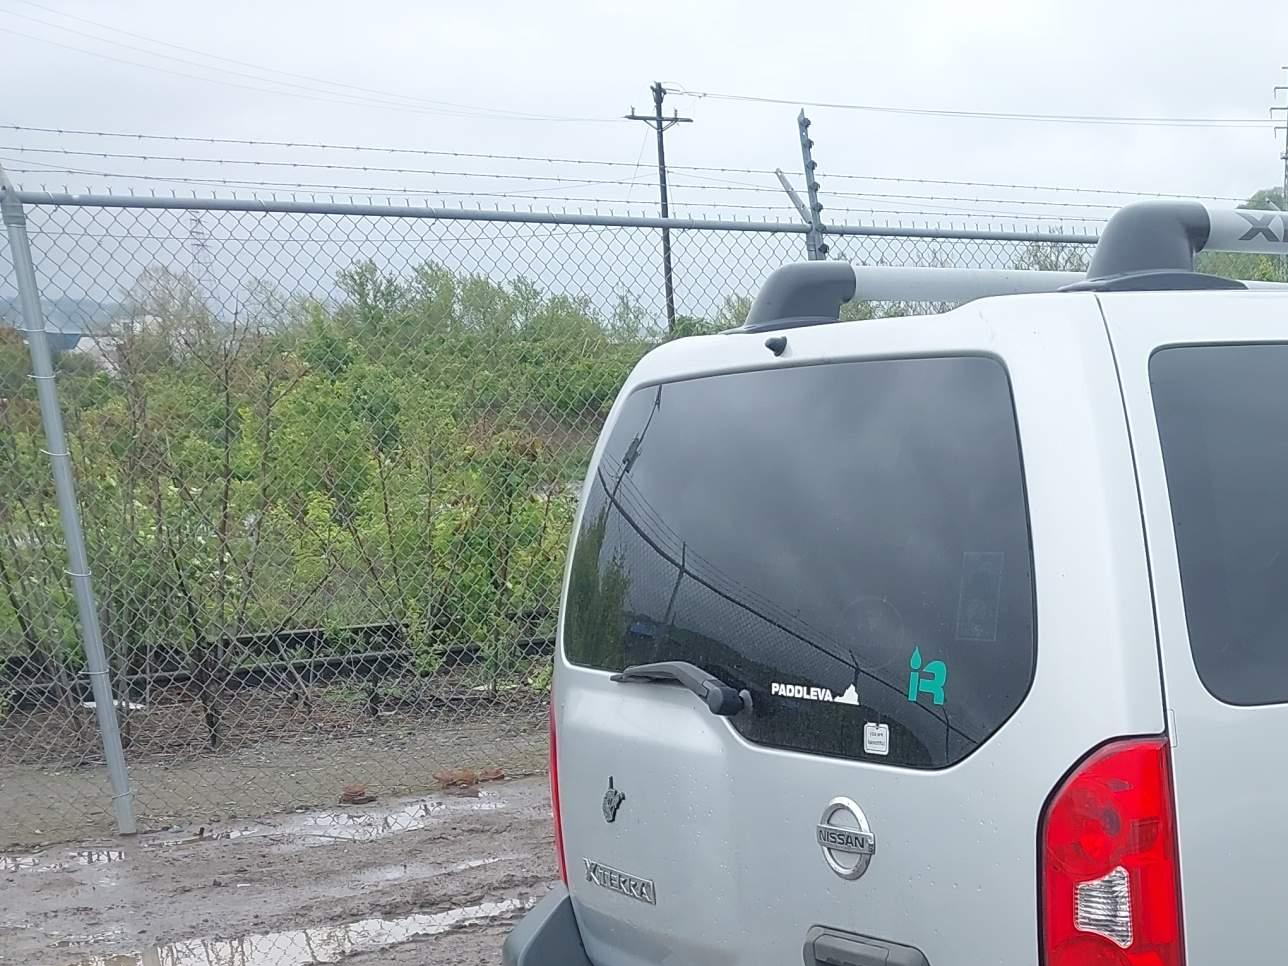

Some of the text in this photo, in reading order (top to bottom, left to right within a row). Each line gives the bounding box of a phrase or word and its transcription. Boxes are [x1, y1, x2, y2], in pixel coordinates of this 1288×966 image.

[771, 682, 833, 702] PADDLEVA
[819, 829, 865, 849] NISSAN
[583, 857, 656, 905] XTERRA
